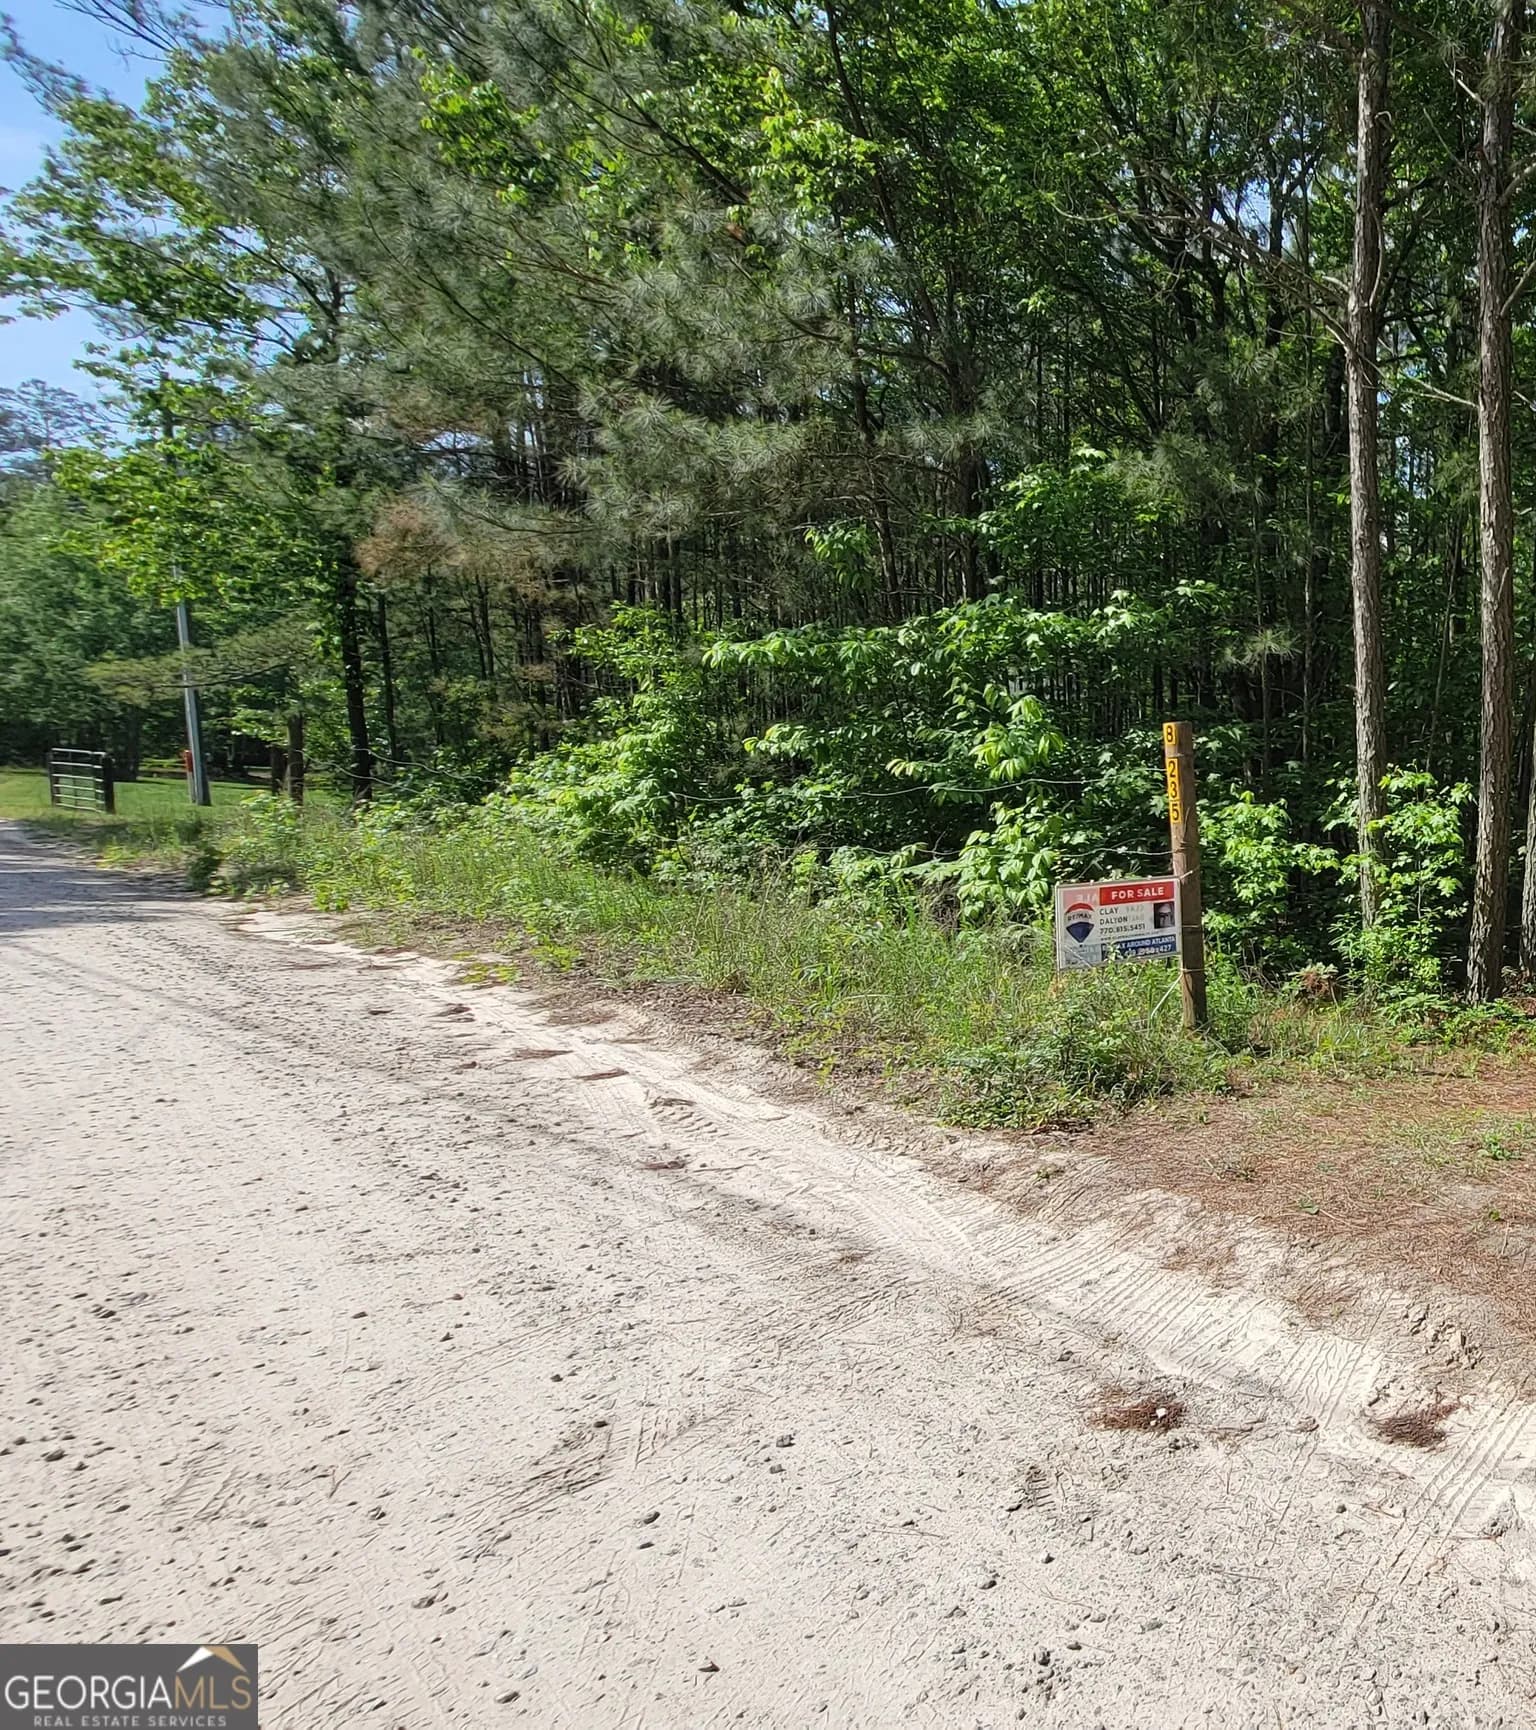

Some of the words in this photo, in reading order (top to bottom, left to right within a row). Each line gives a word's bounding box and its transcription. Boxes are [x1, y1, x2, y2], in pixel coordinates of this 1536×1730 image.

[1165, 725, 1180, 821] 8235
[1111, 890, 1135, 900] FOR
[1137, 887, 1165, 898] SALE
[1099, 907, 1119, 916] CLAY
[1099, 916, 1128, 925] DALTON
[1151, 936, 1175, 946] ATLANTA
